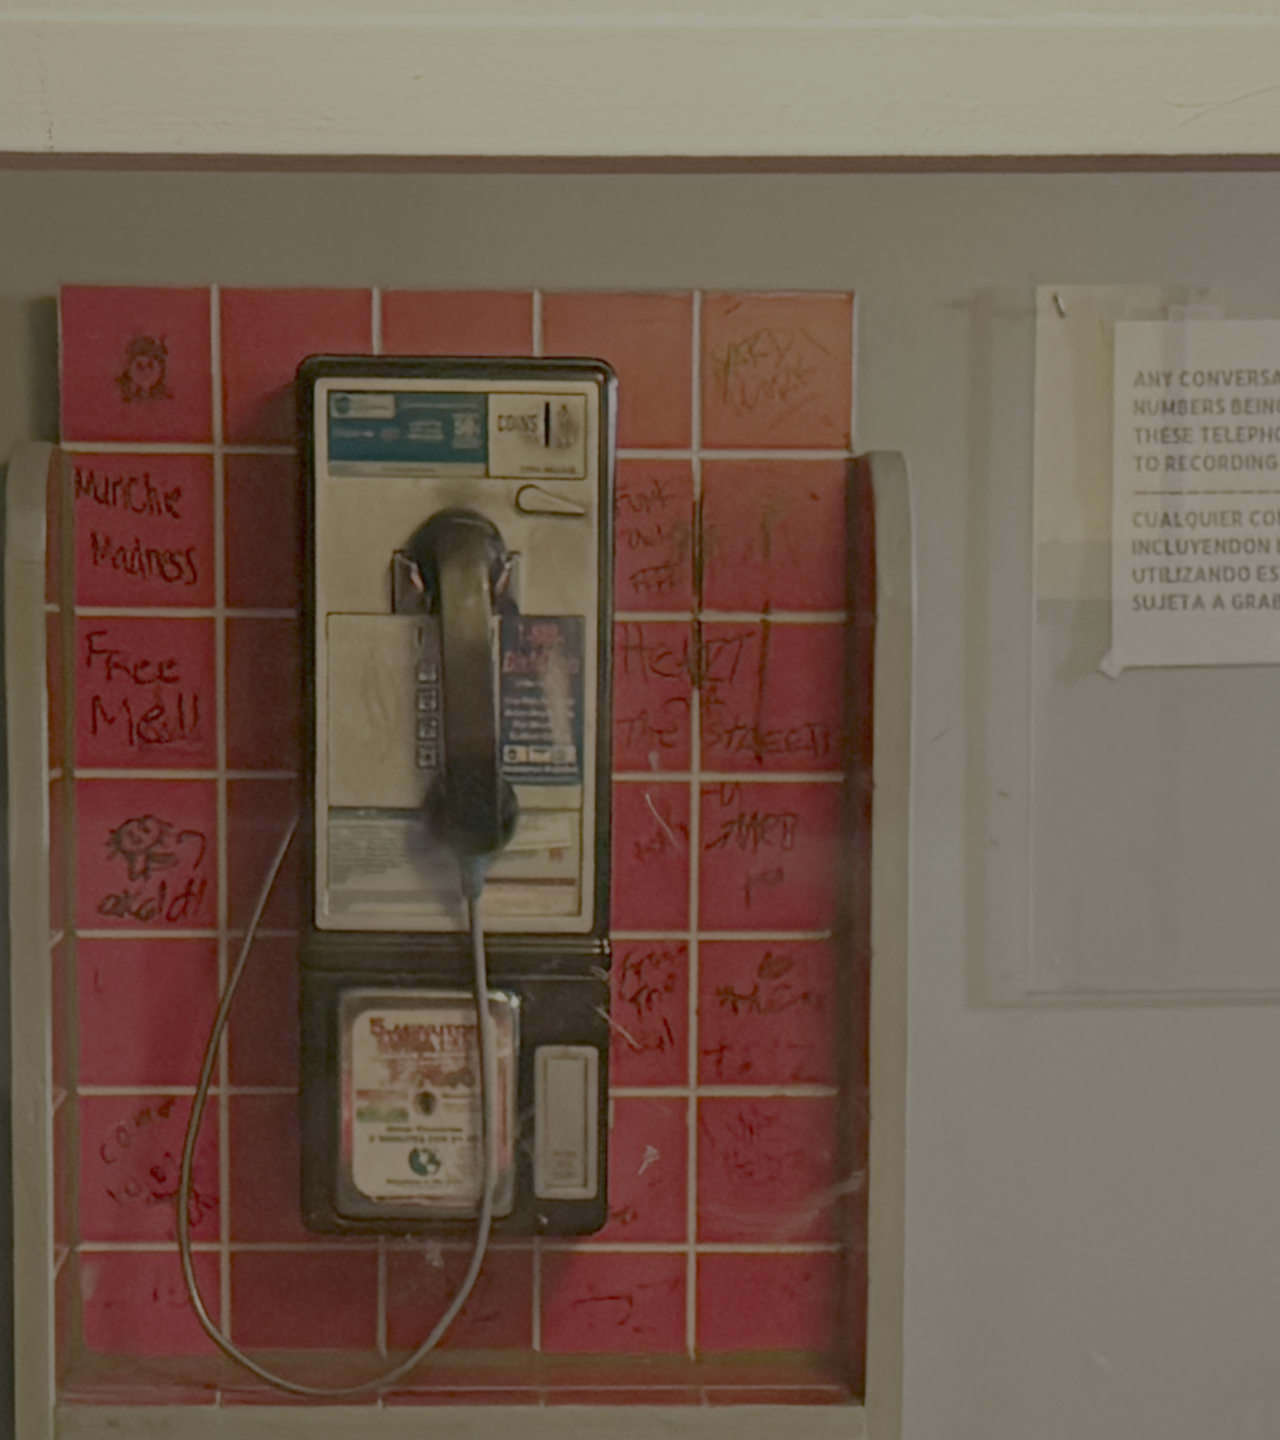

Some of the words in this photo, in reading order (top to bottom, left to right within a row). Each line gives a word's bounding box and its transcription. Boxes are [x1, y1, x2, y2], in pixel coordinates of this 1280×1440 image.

[1134, 370, 1172, 387] ANY
[1133, 398, 1225, 416] NUMBERS
[1134, 427, 1193, 445] THESE
[1134, 456, 1159, 472] TO
[1165, 454, 1277, 472] RECORDING
[1132, 510, 1243, 529] CUALQUIER
[1132, 537, 1270, 556] INCLUYENDON
[1132, 566, 1250, 583] UTILIZANDO
[1132, 594, 1205, 611] SUJETA
[1212, 594, 1225, 610] A
